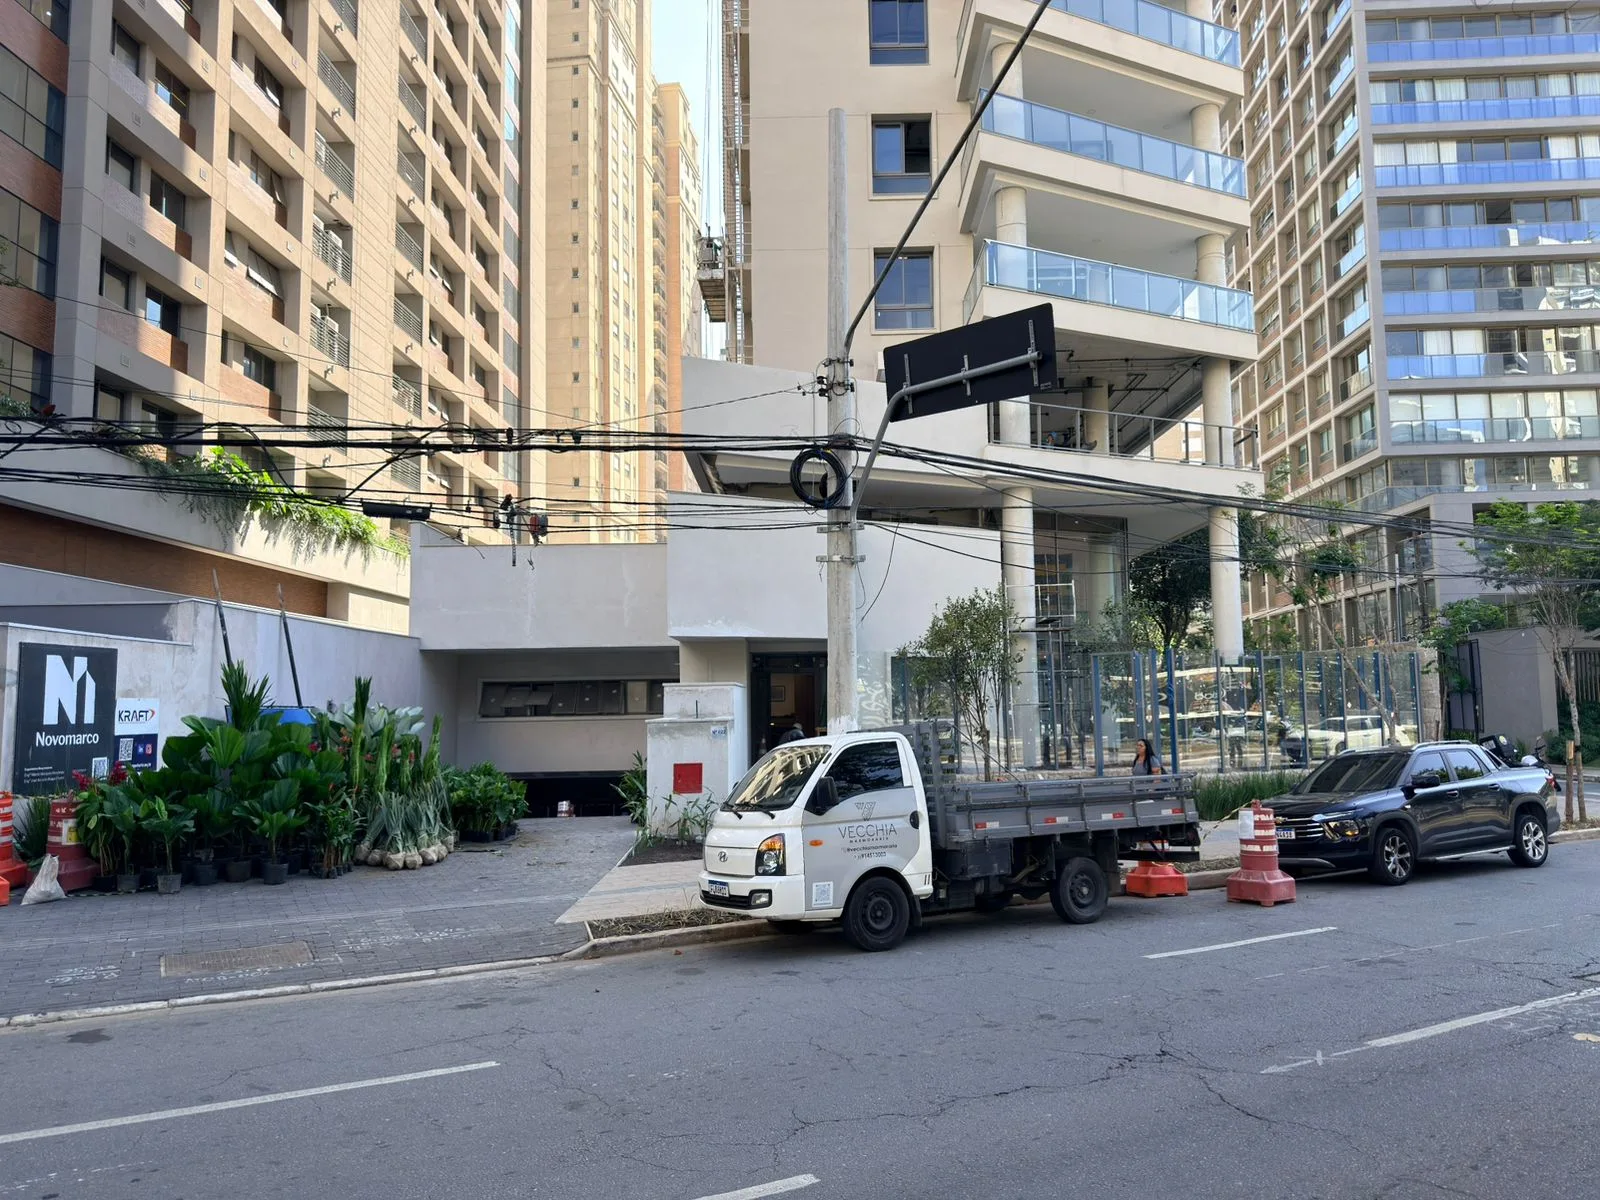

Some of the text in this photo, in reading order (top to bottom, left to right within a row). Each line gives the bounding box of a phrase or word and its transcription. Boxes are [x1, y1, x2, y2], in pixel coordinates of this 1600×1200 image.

[118, 710, 149, 722] KRAFT
[35, 731, 100, 747] Novomarco
[838, 823, 898, 839] VECCHIA
